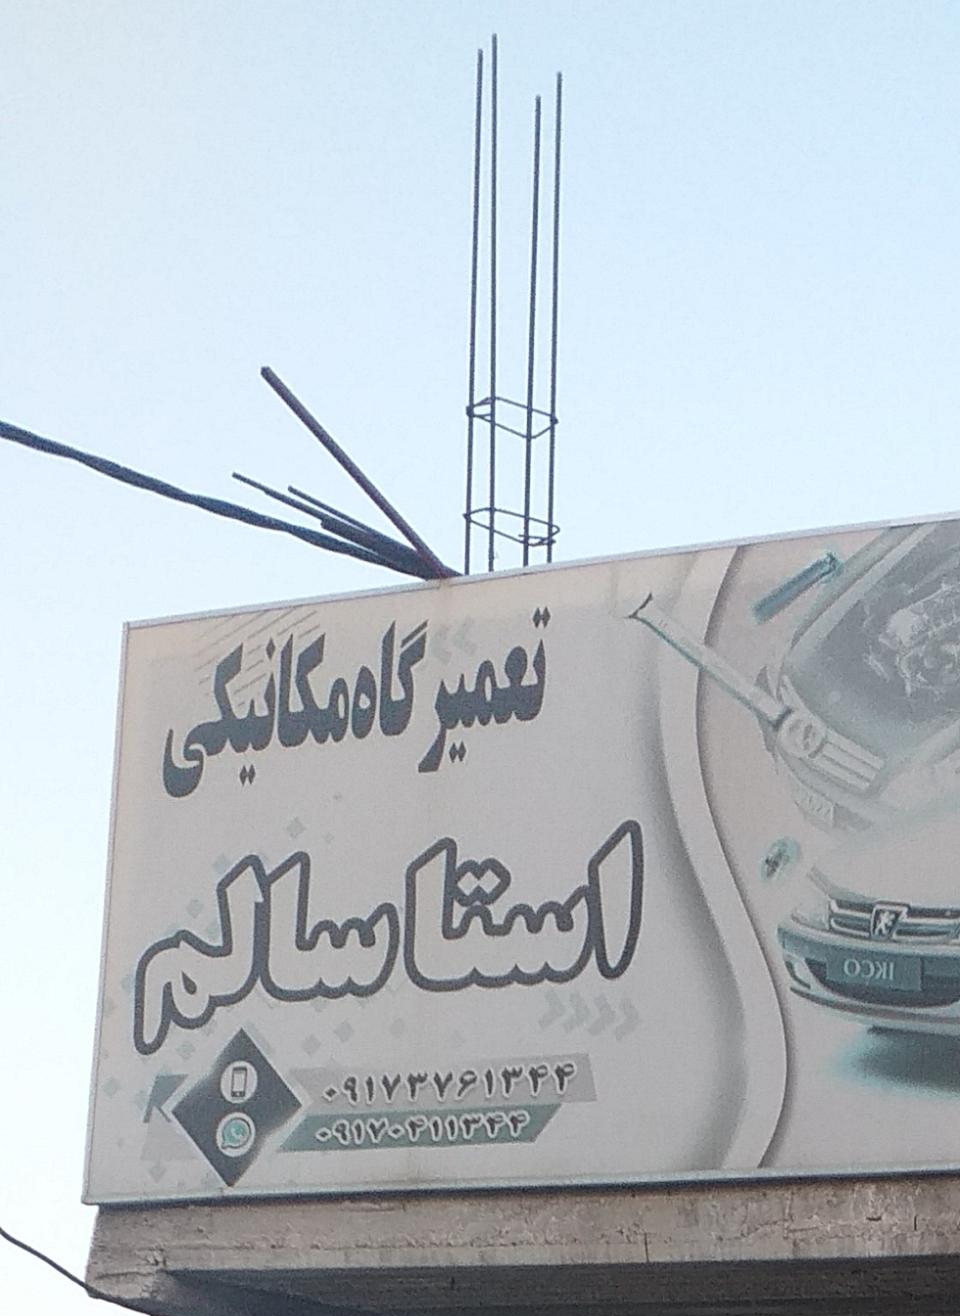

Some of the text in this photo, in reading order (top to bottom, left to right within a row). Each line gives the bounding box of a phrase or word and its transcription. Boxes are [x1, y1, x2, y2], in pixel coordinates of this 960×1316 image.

[133, 819, 644, 1055] استا سالم
[323, 1061, 576, 1105] ۰۹۱۷۳۷۶۱۳۴۴
